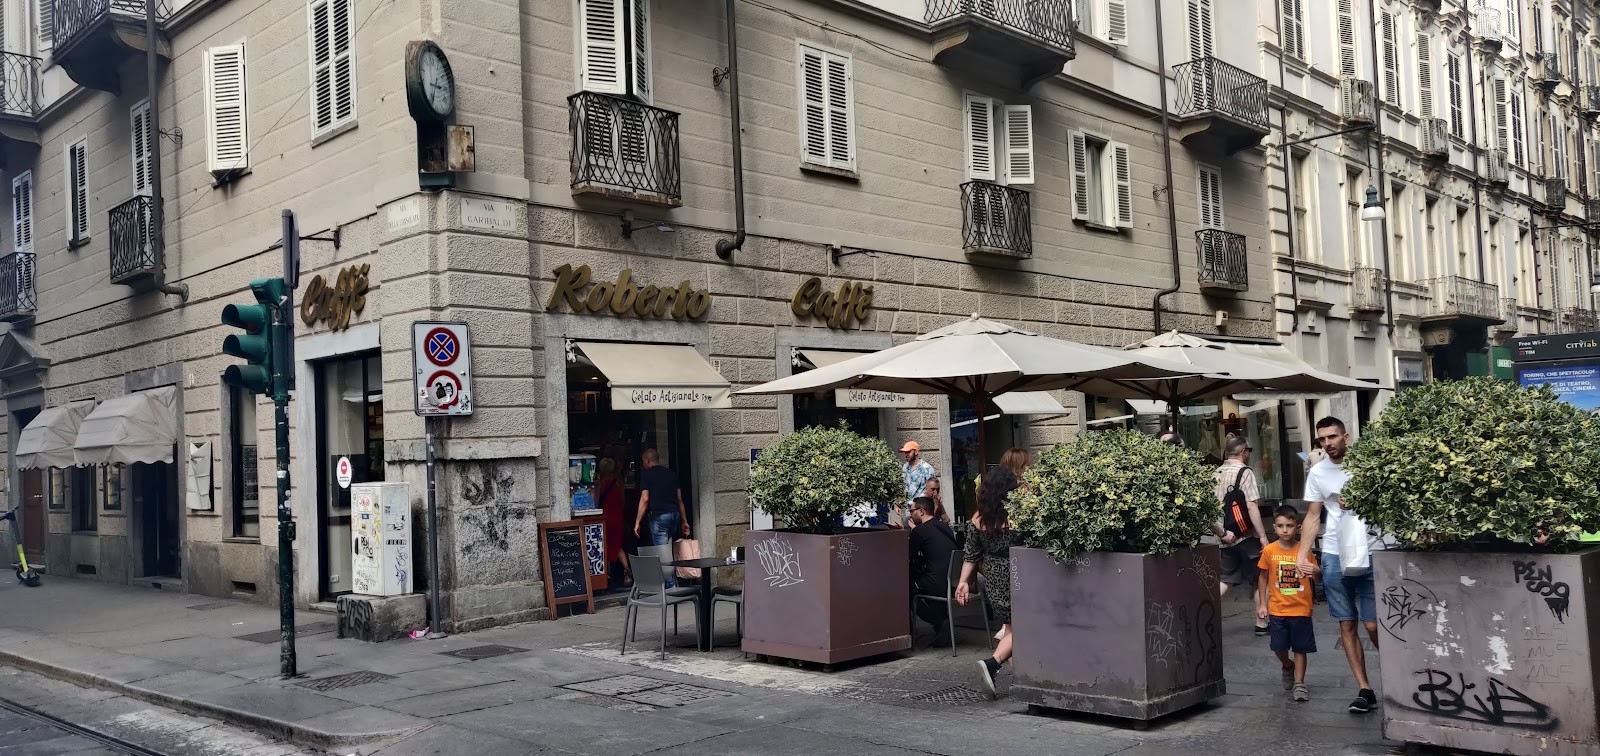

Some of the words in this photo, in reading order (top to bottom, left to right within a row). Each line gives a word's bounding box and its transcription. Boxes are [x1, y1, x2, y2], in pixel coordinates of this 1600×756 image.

[483, 203, 495, 212] VIA
[467, 215, 512, 227] GARIBALDI
[546, 263, 710, 320] Roberto
[790, 277, 875, 330] Caffè
[631, 390, 657, 404] Gelato
[848, 390, 867, 402] Gelato
